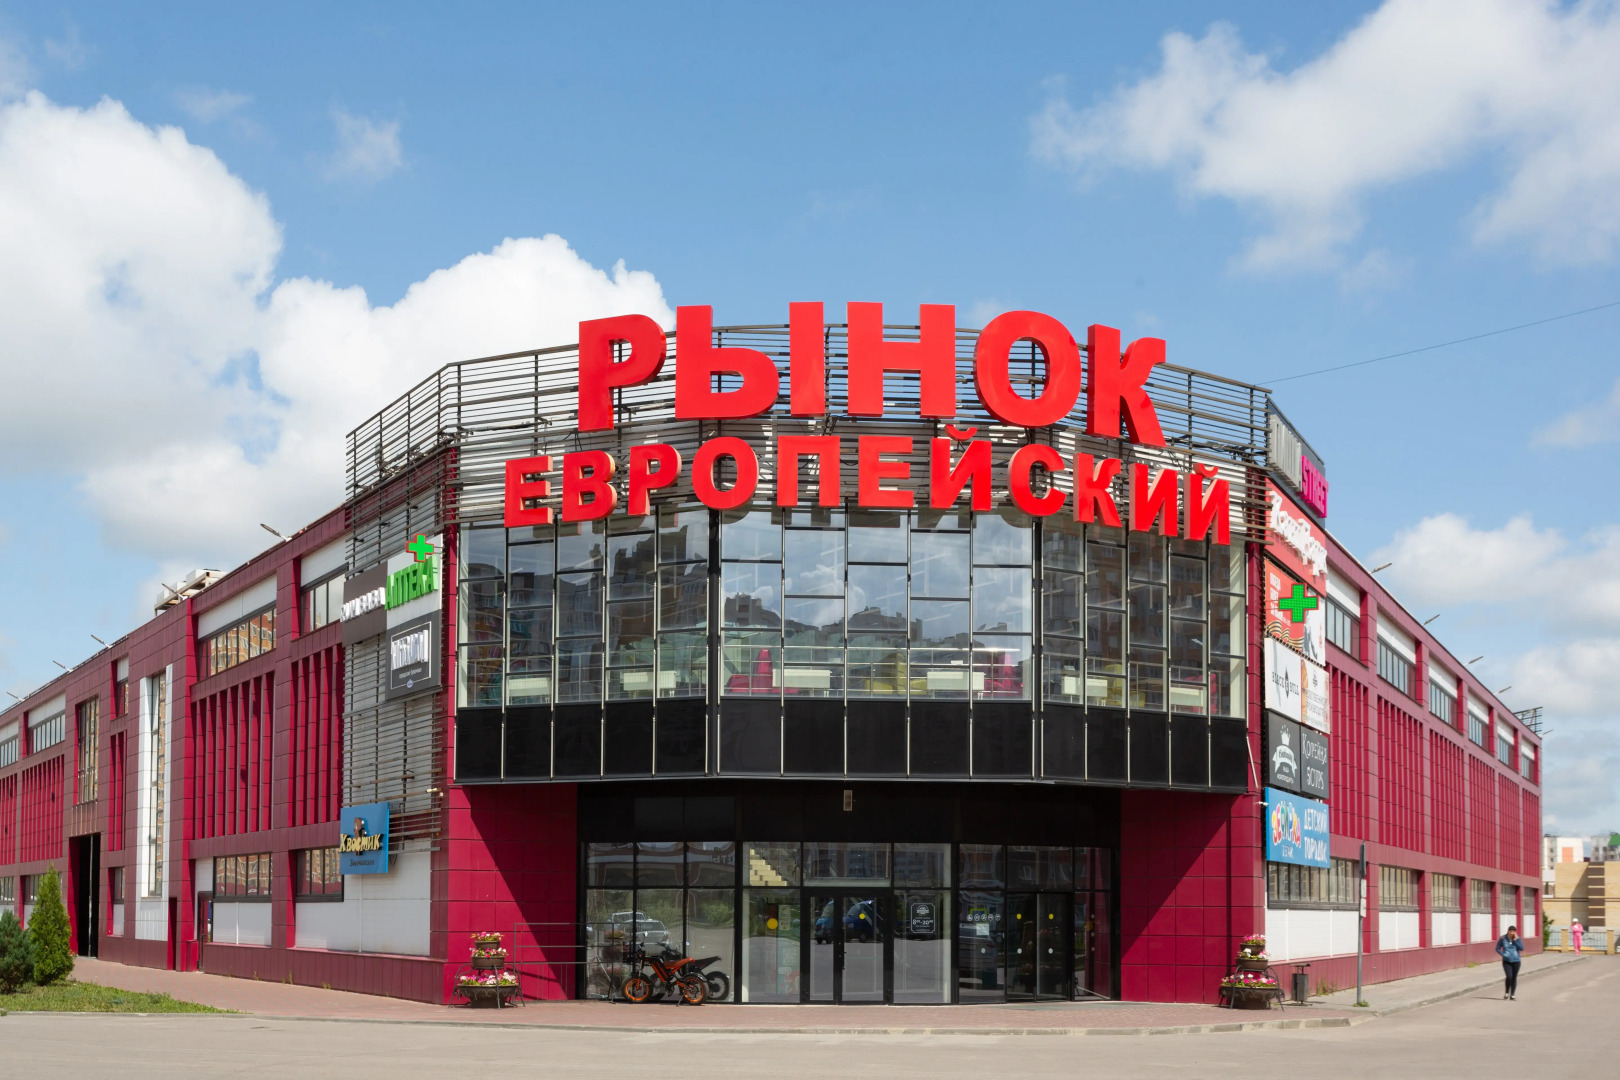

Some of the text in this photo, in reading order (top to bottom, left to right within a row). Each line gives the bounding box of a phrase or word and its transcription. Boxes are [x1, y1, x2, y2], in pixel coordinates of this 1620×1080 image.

[578, 301, 1166, 448] РЫНОК
[504, 424, 1230, 545] ЕВРОПЕЙСКИЙ
[384, 555, 438, 610] АПТЕКА
[1304, 808, 1327, 833] ДЕТСКИЙ
